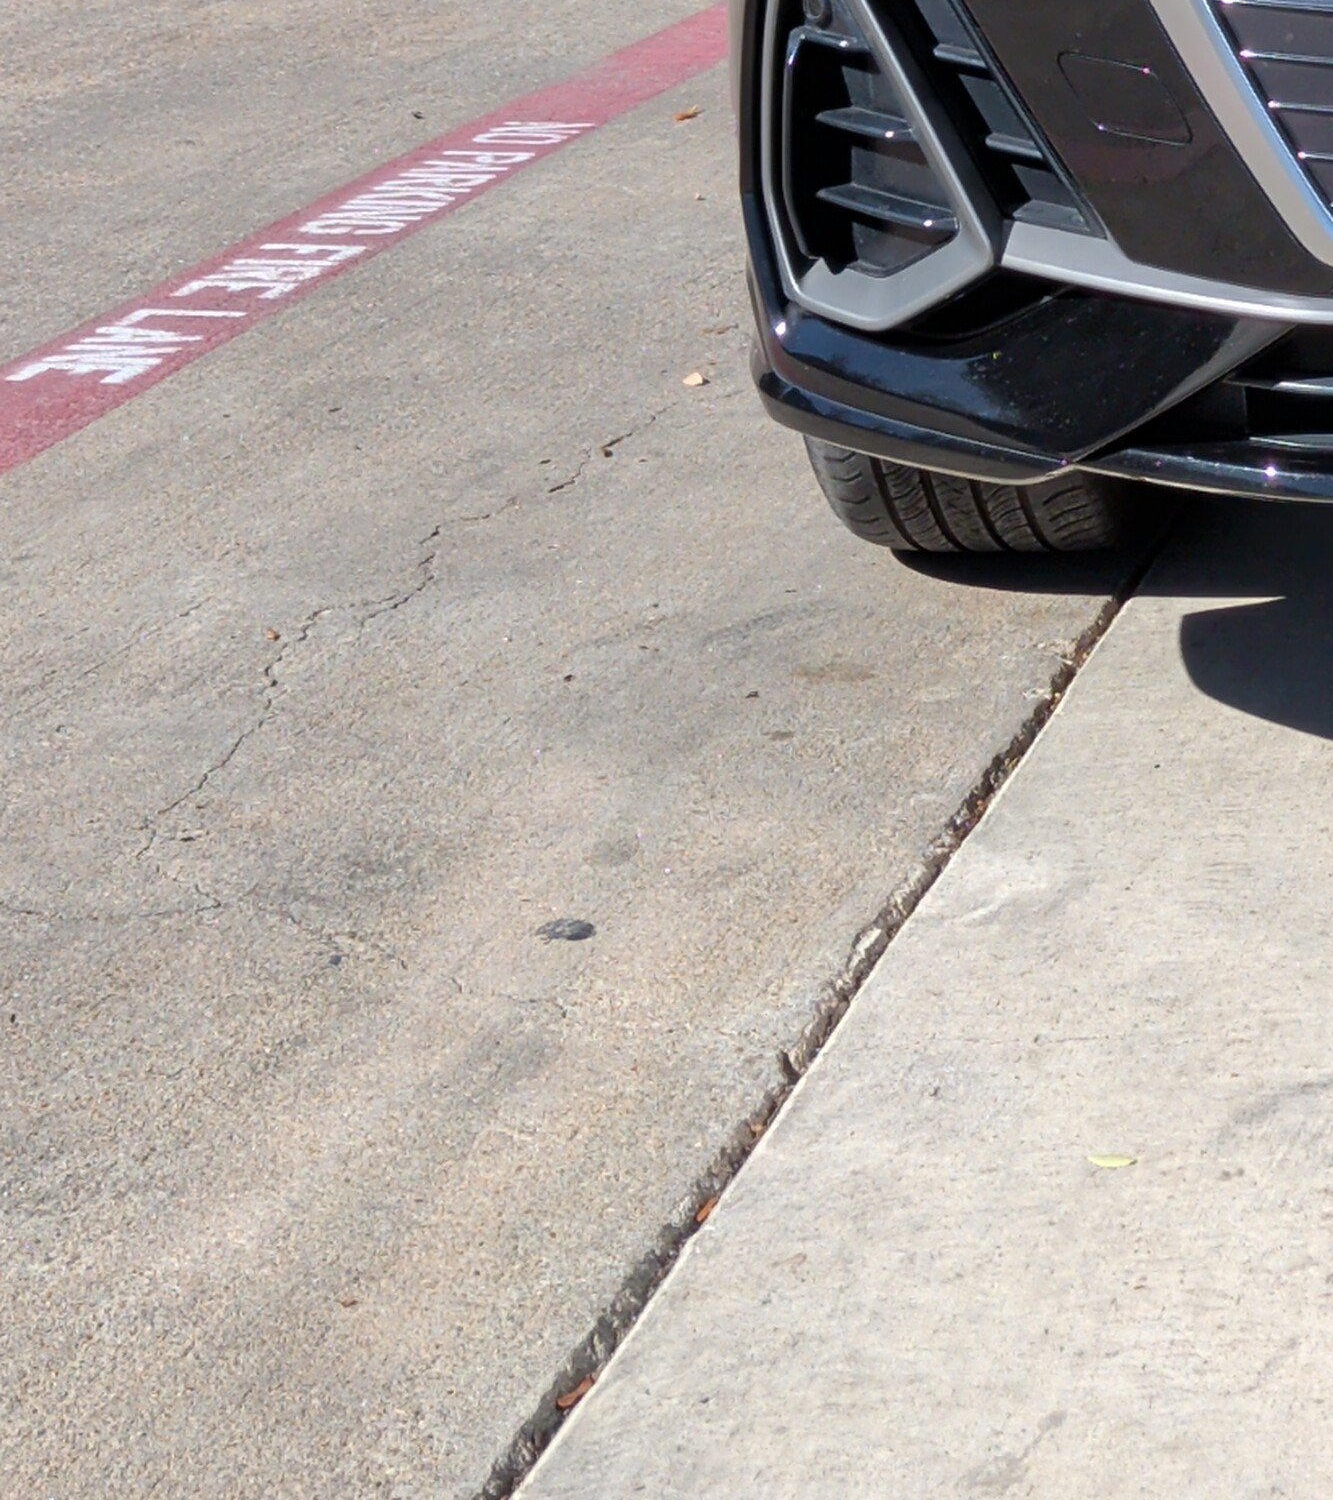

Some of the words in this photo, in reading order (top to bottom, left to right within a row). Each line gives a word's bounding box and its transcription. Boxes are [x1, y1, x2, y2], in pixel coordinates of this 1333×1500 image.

[472, 121, 596, 145] NO
[298, 150, 536, 235] PARKING
[169, 243, 367, 299] FIRE
[4, 308, 248, 384] LANE
